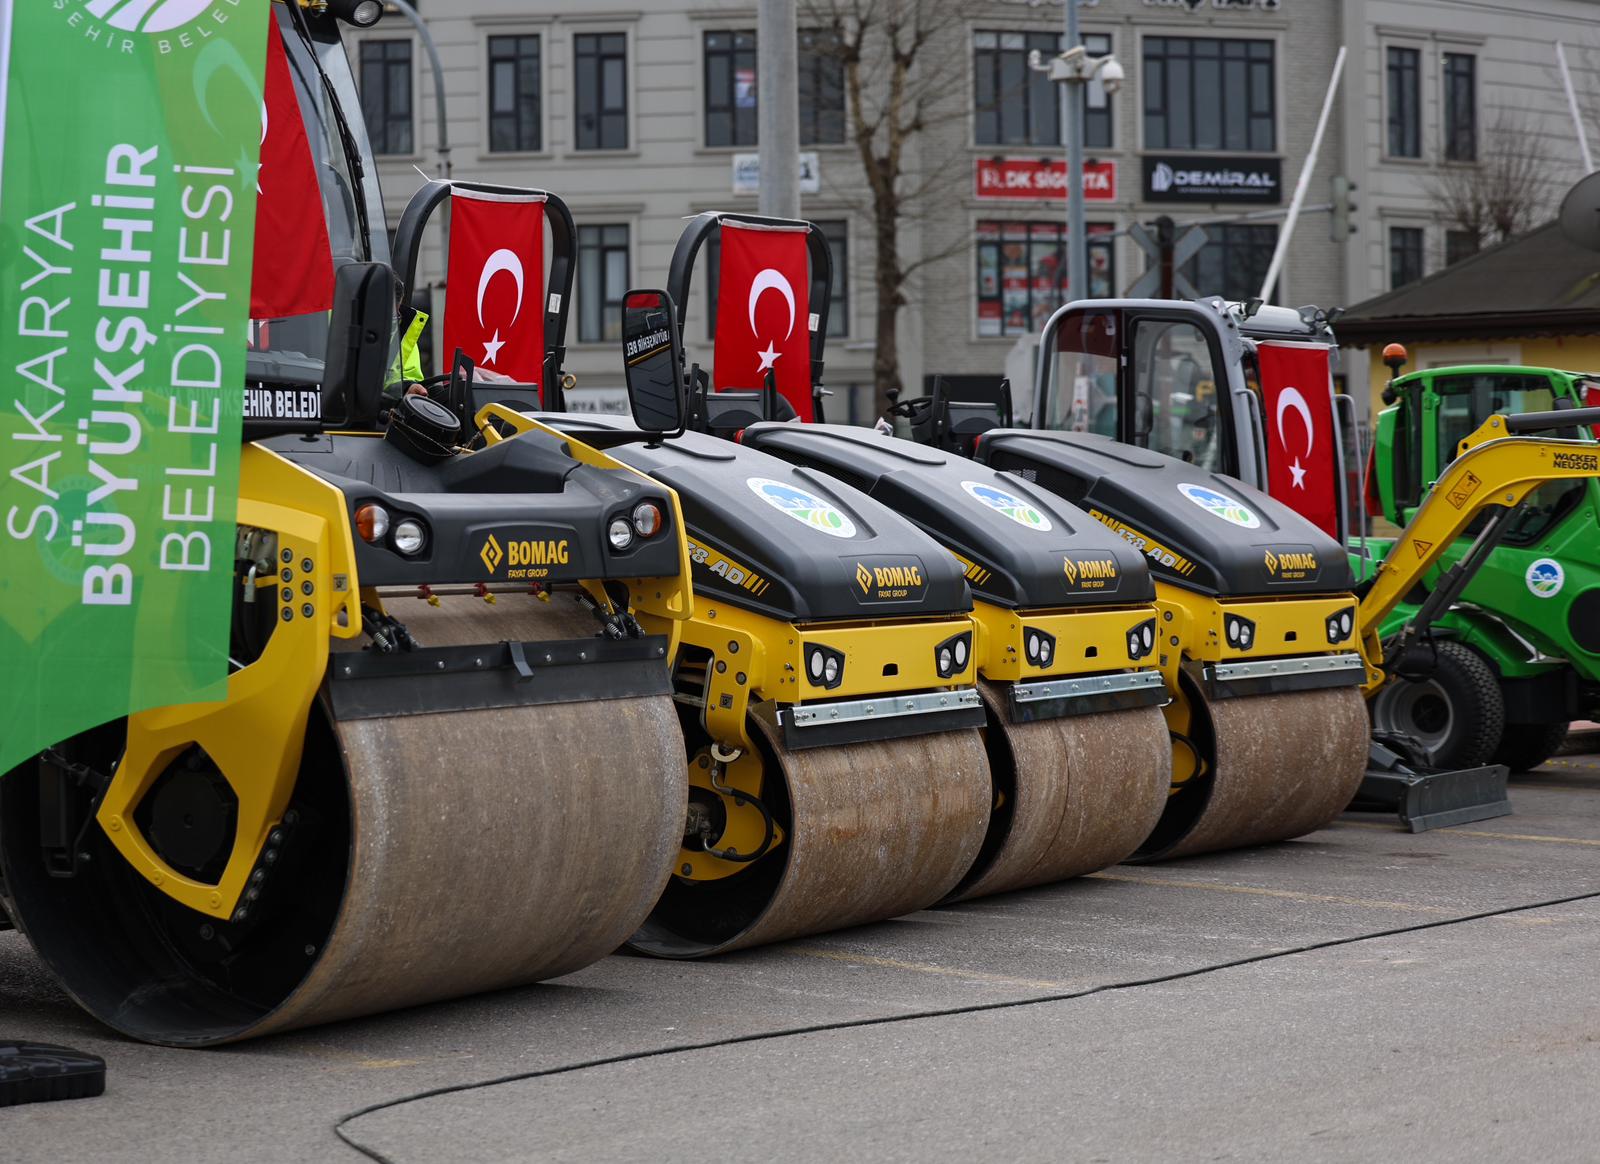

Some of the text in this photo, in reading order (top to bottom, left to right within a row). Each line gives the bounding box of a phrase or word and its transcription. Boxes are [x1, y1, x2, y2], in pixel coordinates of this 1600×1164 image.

[7, 202, 76, 542] SAKARYA
[72, 143, 159, 605] BÜYÜKŞEHİR
[160, 165, 235, 571] BELEDİYESİ
[1553, 452, 1598, 463] WACKER
[1553, 460, 1598, 471] NEUSON
[508, 540, 569, 566] BOMAG
[1278, 552, 1317, 570] BOMAG
[508, 568, 549, 578] FAYAT GROUP
[709, 559, 744, 585] AD
[873, 566, 922, 587] BOMAG
[1077, 559, 1116, 579] BOMAG
[892, 589, 908, 598] GROUP
